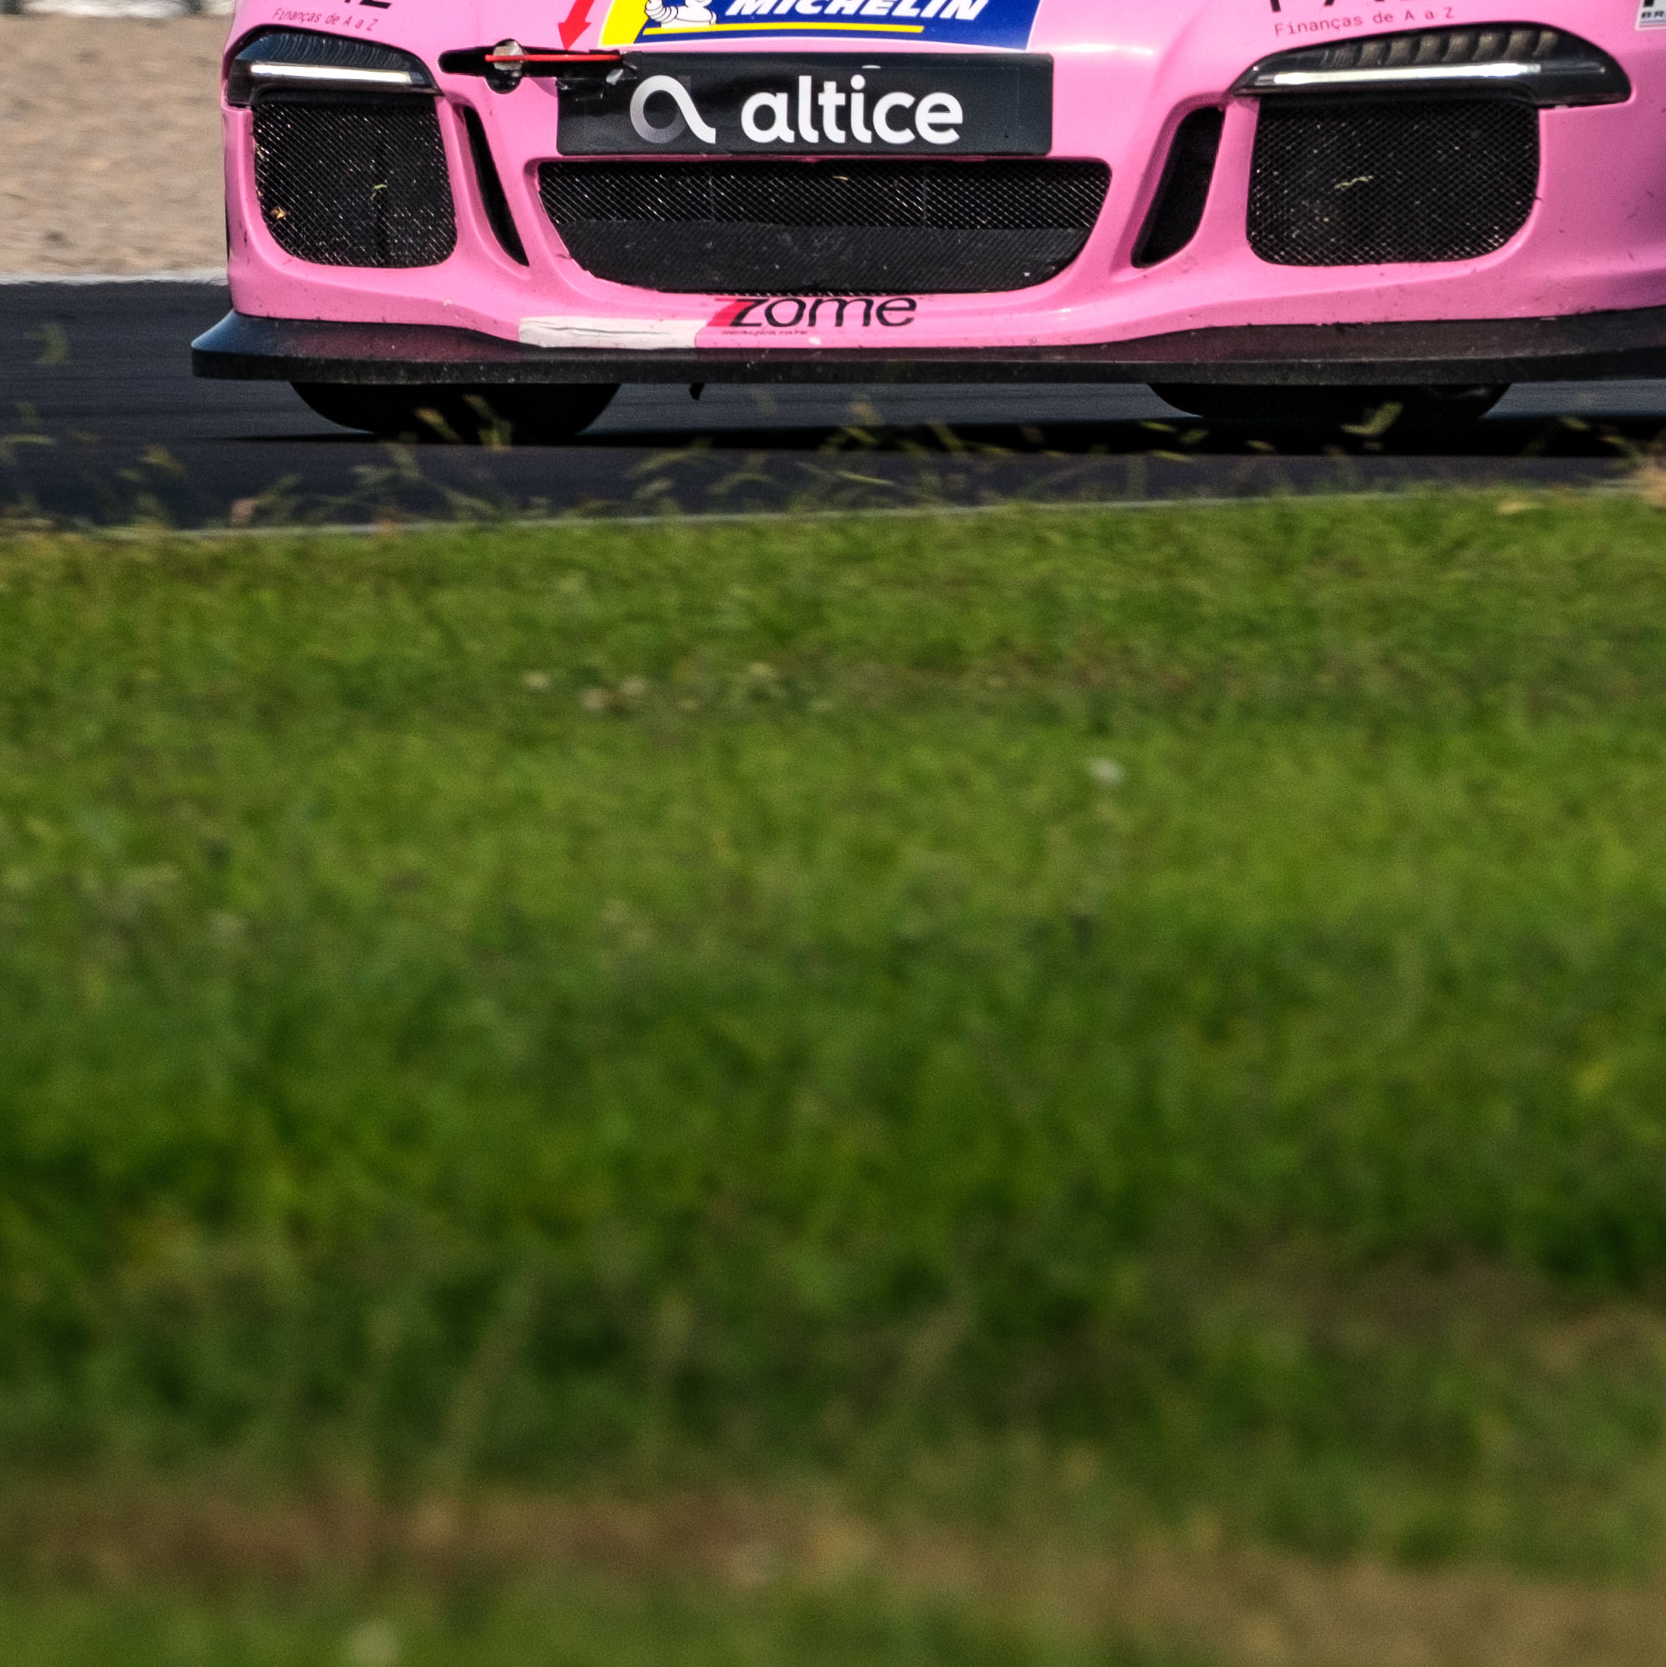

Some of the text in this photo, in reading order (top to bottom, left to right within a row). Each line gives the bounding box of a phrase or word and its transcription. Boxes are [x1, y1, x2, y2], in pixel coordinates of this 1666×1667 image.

[271, 8, 322, 24] Finanças
[325, 13, 340, 25] de
[1274, 7, 1455, 37] Finanças de A a Z
[741, 74, 965, 144] altice
[708, 297, 918, 328] zome
